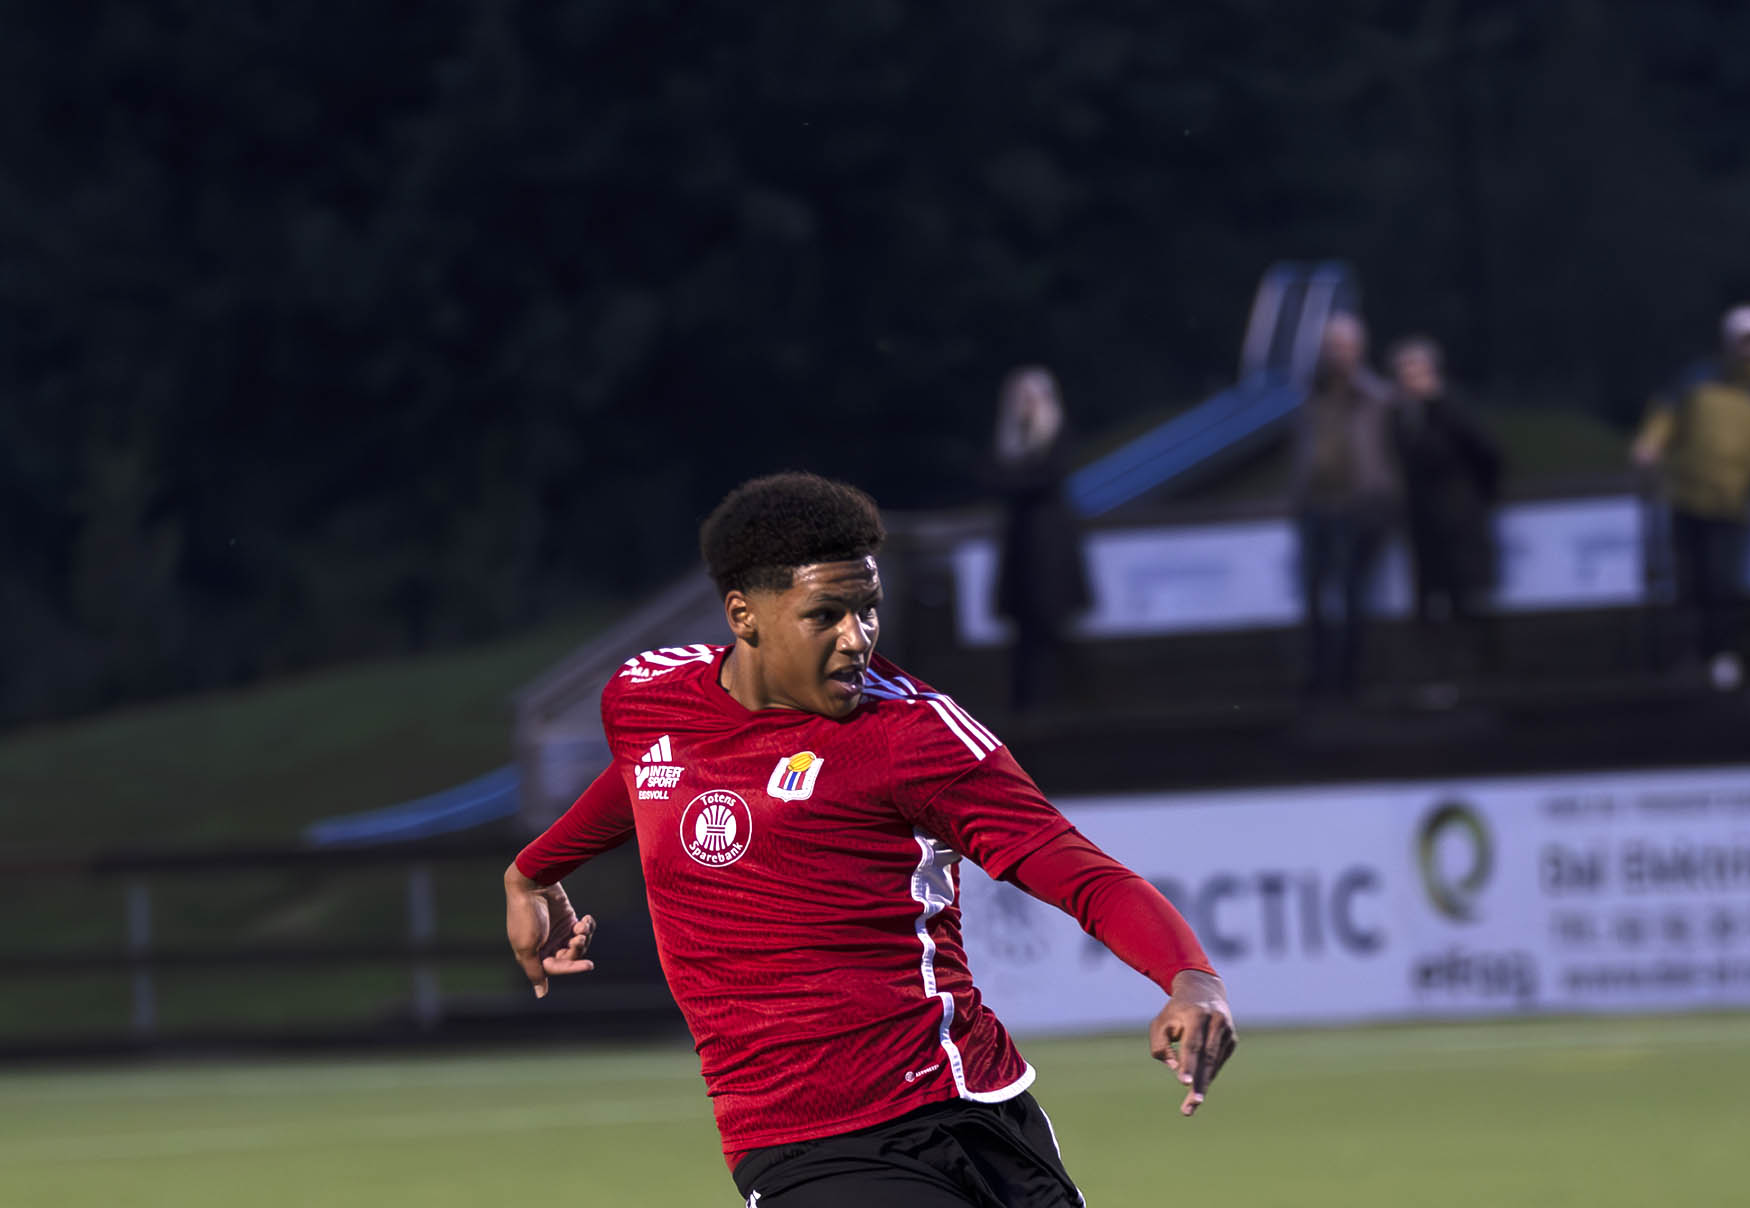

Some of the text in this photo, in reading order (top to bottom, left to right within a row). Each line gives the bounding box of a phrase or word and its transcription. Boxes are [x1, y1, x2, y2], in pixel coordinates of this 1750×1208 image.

[650, 765, 683, 778] INTER
[647, 777, 680, 788] SPORT
[700, 793, 736, 807] Totens
[689, 840, 743, 863] Sparebank
